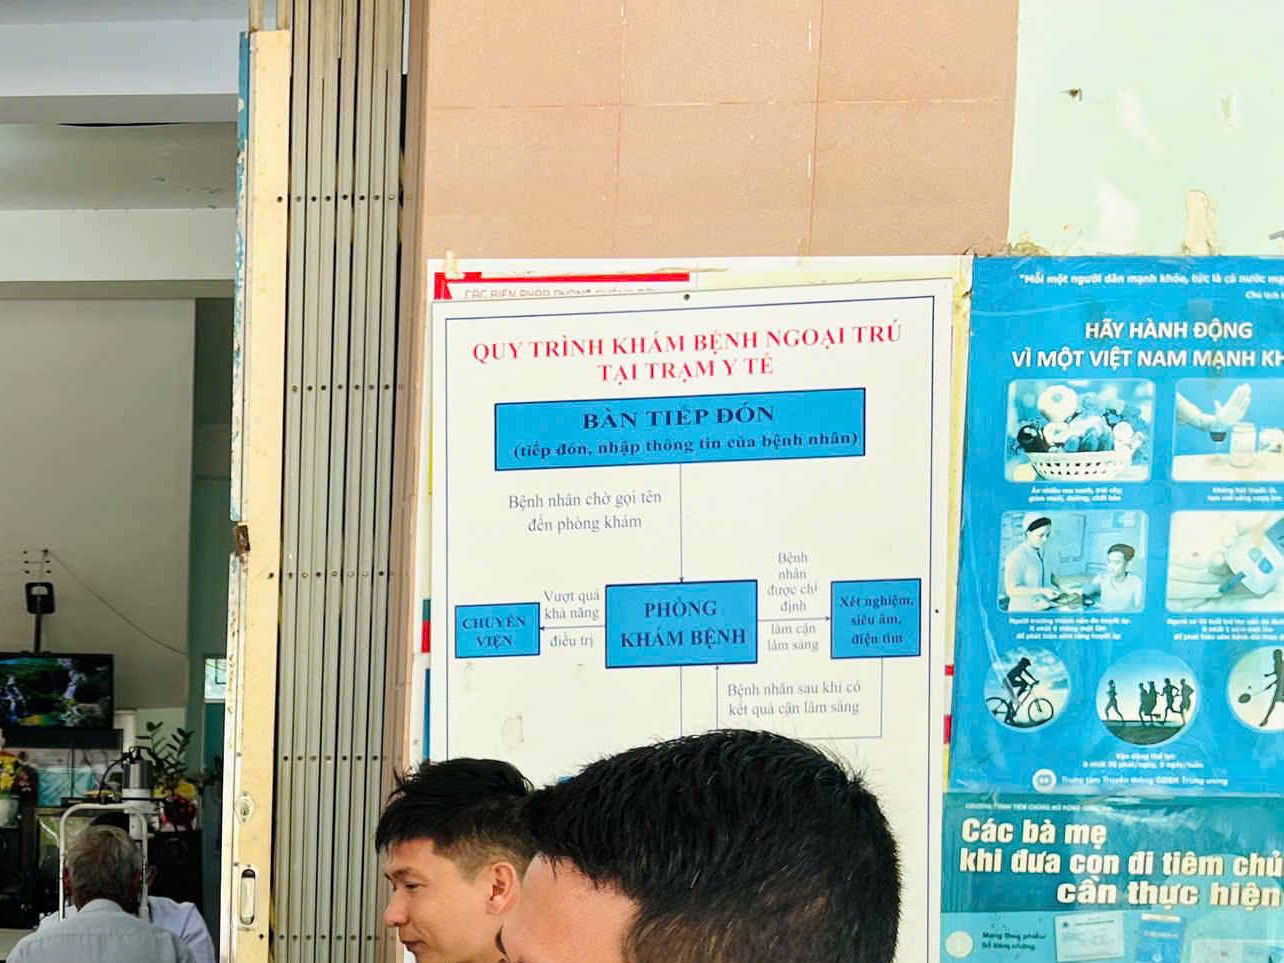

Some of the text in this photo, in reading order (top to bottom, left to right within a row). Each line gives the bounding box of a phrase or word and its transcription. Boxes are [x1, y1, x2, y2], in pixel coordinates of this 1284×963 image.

[1085, 318, 1252, 342] HÃY HÀNH ĐỘNG
[473, 319, 901, 364] QUY TRÌNH KHÁM BỆNH NGOẠI TRÚ
[1012, 347, 1031, 367] VÌ
[1037, 346, 1084, 371] MỘT
[1089, 346, 1132, 370] VIỆT
[1137, 351, 1187, 367] NAM
[1193, 350, 1255, 370] MẠNH
[598, 352, 773, 385] TẠI TRẠM Y TẾ
[583, 402, 775, 430] BÀN TIẾP ĐÓN
[556, 442, 592, 456] đón,
[598, 440, 640, 456] nhập
[646, 437, 693, 454] thông
[700, 437, 721, 449] tin
[727, 435, 756, 449] của
[762, 433, 803, 450] bệnh
[809, 431, 858, 447] nhân)
[509, 489, 661, 511] Bệnh nhân chờ gọi tên
[528, 514, 642, 533] đến phòng khám
[778, 551, 808, 565] Bệnh
[779, 568, 806, 580] nhân
[544, 591, 574, 603] Vượt
[767, 584, 796, 596] được
[644, 596, 717, 618] PHÒNG
[781, 600, 806, 614] định
[840, 596, 861, 608] Xét
[545, 607, 600, 622] khả năng
[852, 613, 875, 625] siêu
[621, 626, 746, 649] KHÁM BỆNH
[771, 623, 816, 636] làm cận
[476, 633, 513, 650] VIỆN
[550, 633, 594, 648] điều trị
[767, 638, 819, 653] lâm sàng
[852, 633, 903, 647] điện tim
[728, 679, 861, 698] Bệnh nhân sau khi có
[729, 699, 859, 718] kết quả cận lâm sàng
[962, 818, 1107, 850] Các bà mẹ
[959, 848, 1284, 878] khi đưa con đi tiêm chủ
[1057, 876, 1280, 912] cần thực hiện
